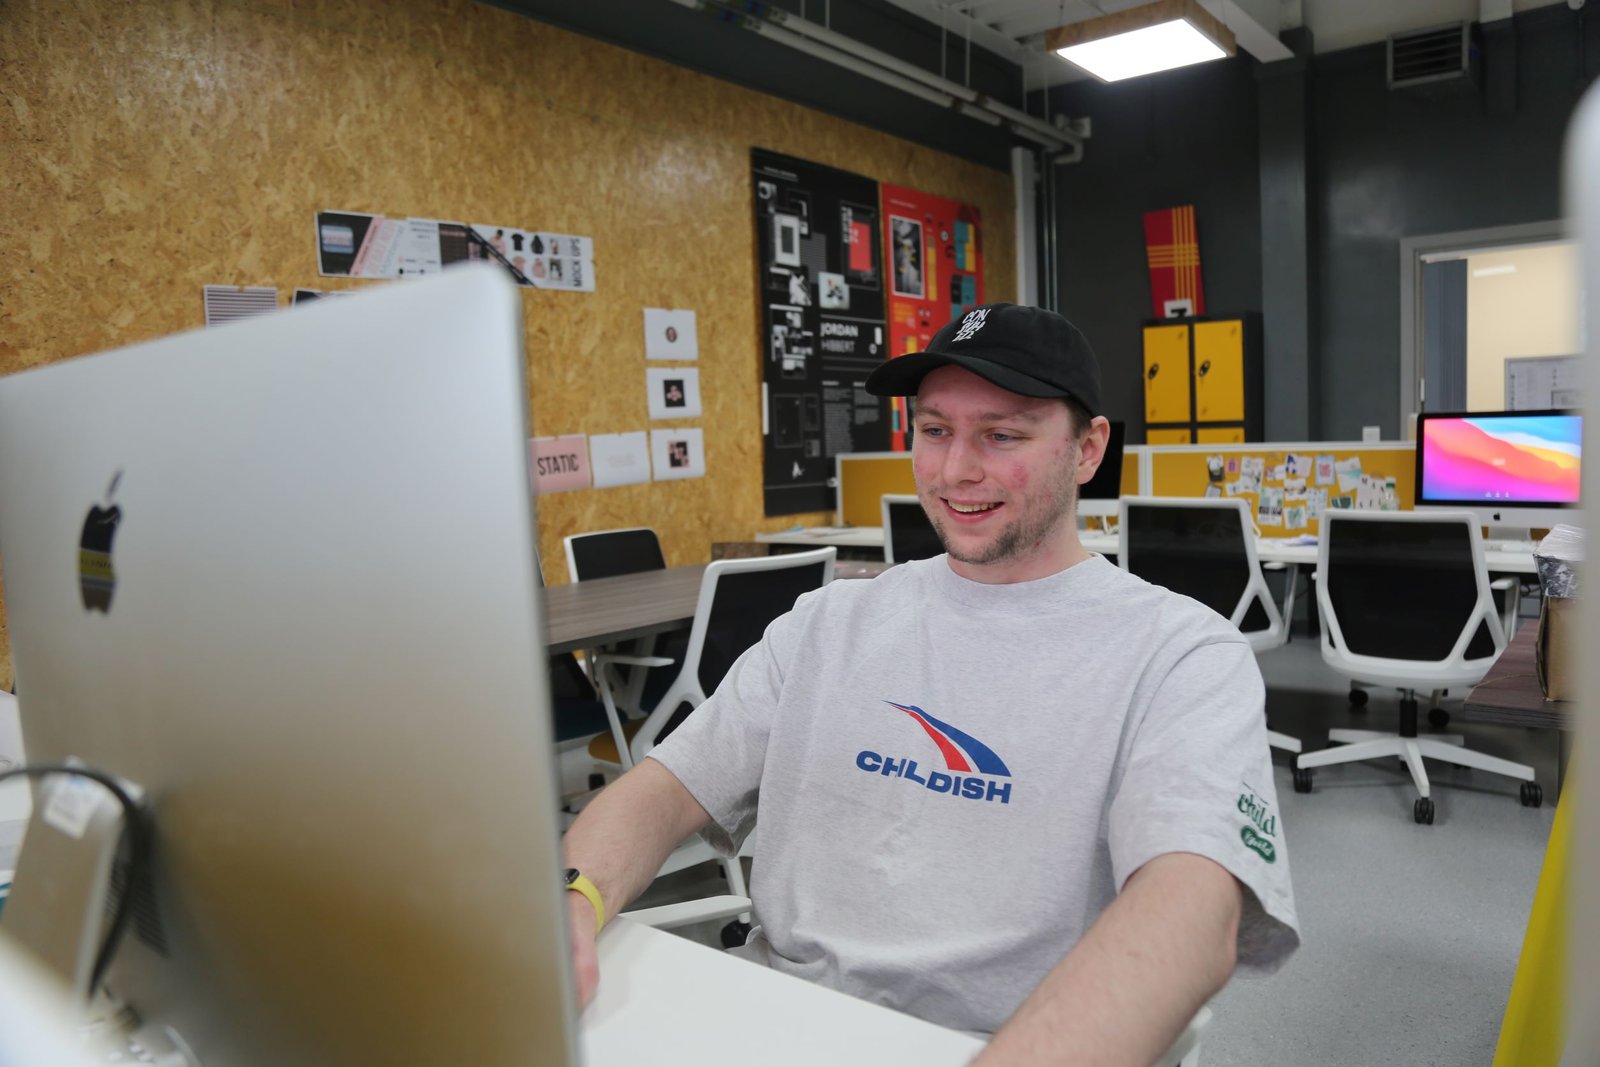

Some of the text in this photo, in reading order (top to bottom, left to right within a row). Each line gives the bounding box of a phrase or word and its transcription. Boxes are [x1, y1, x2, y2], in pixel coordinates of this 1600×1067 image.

[572, 260, 582, 287] MOCK
[820, 322, 859, 337] JORDAN
[537, 453, 580, 477] STATIC
